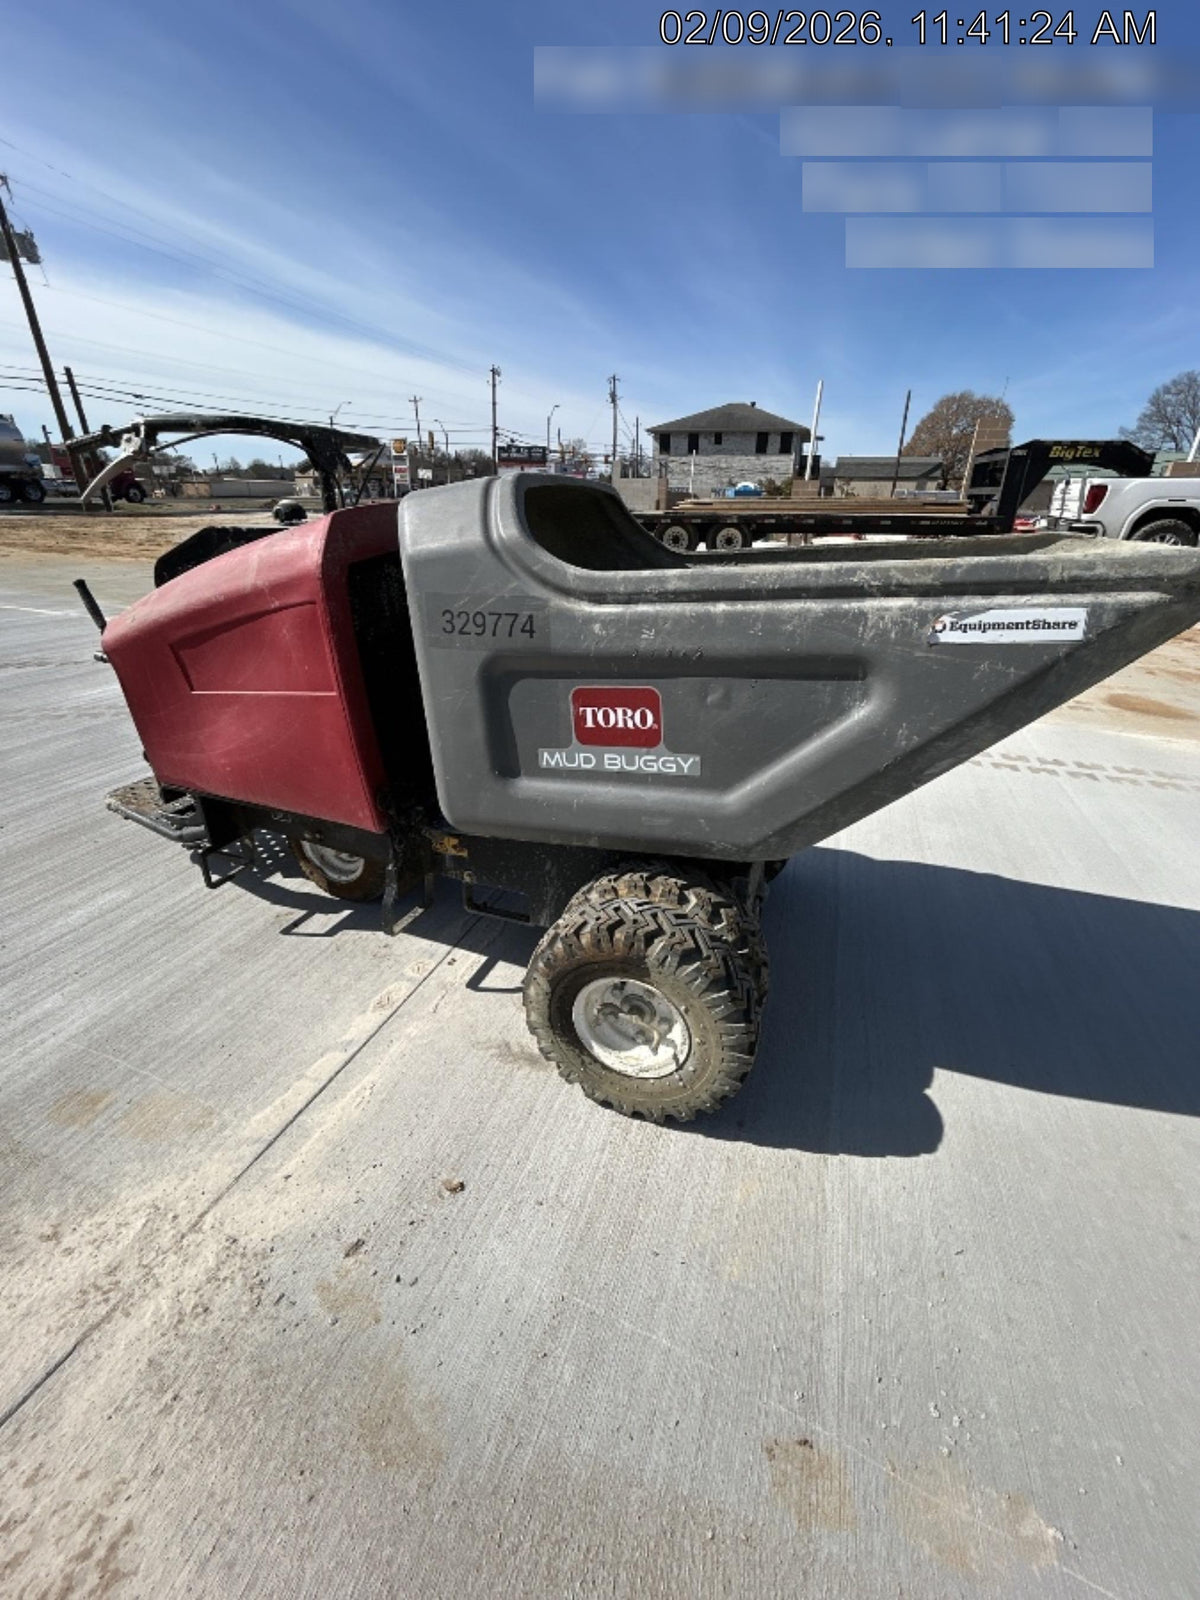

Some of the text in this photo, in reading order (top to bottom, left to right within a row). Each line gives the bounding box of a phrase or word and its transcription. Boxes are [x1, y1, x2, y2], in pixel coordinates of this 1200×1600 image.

[441, 609, 537, 639] 329774
[948, 618, 1078, 634] EquipmentShare
[578, 706, 655, 730] TORO
[542, 750, 697, 774] MUD BUGGY
